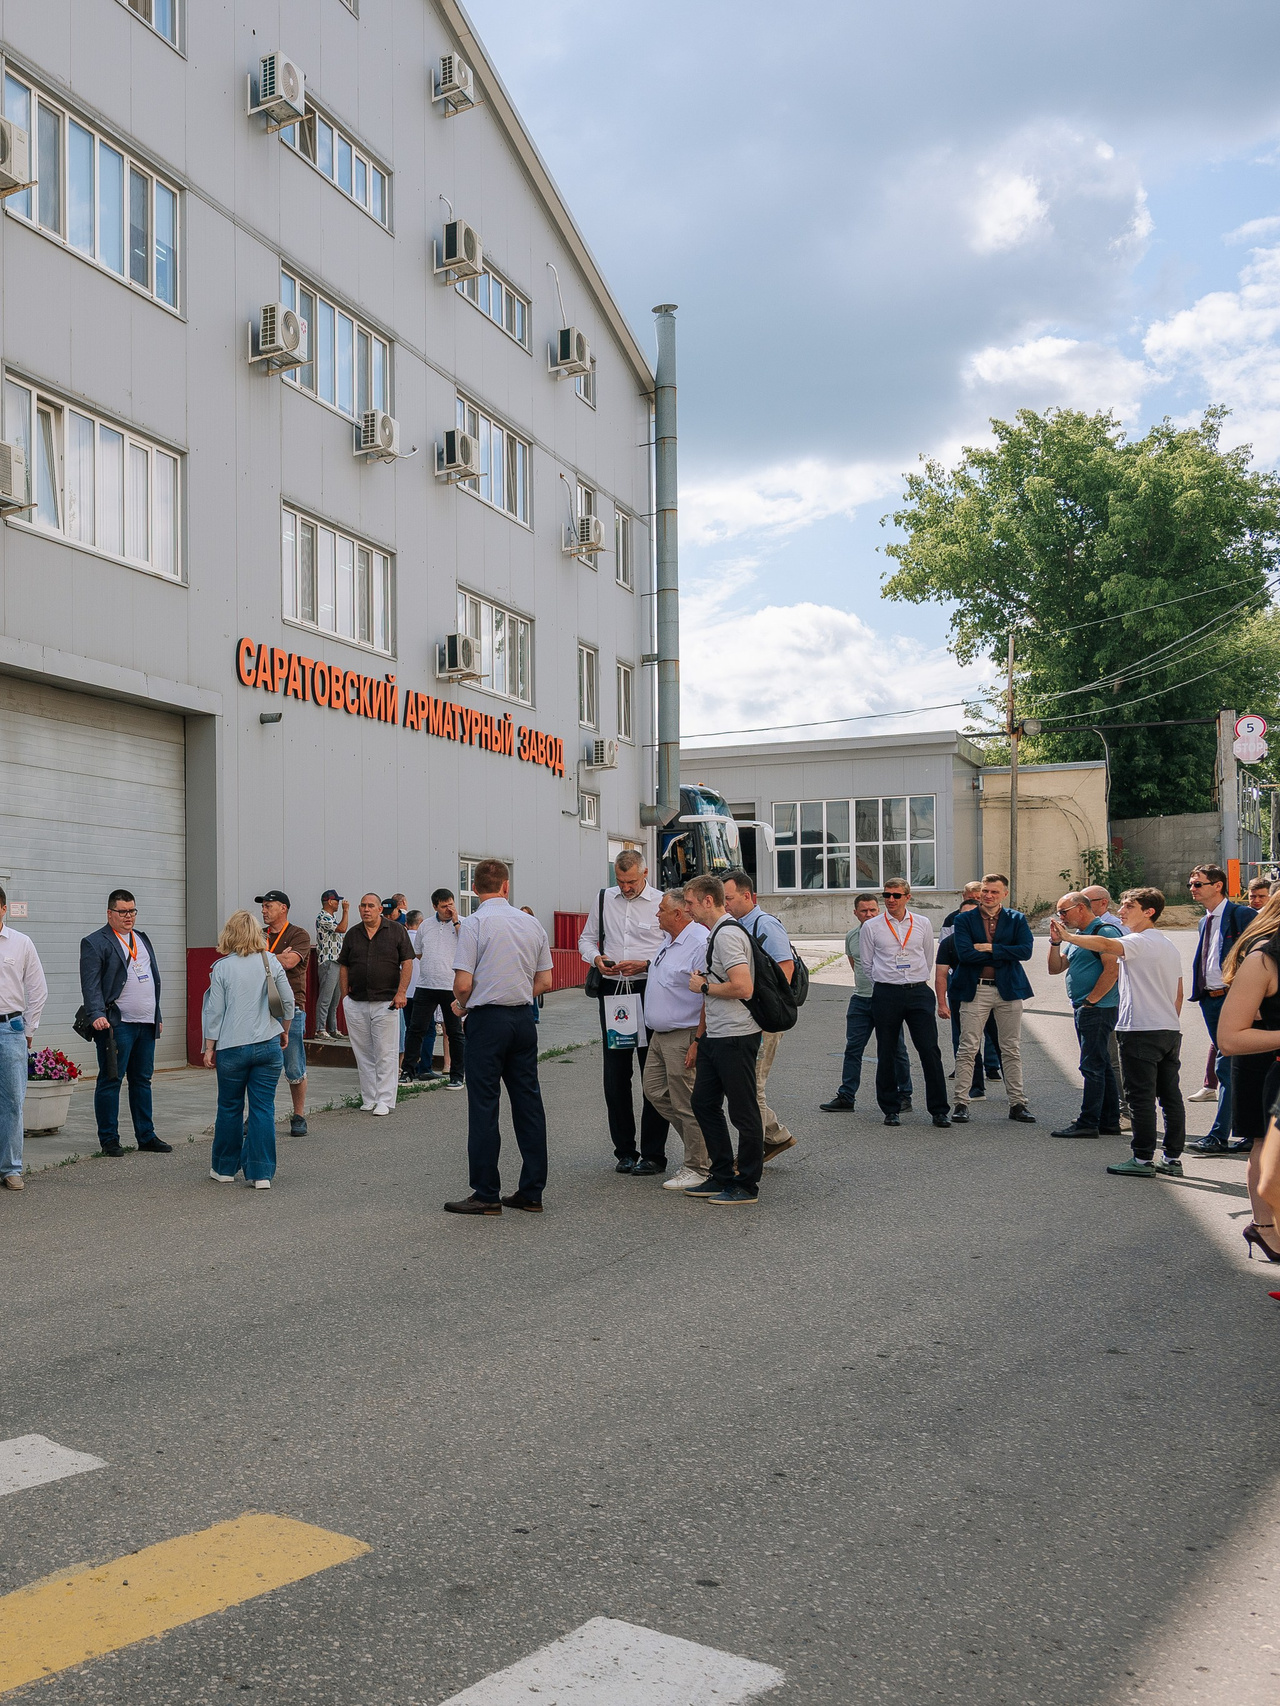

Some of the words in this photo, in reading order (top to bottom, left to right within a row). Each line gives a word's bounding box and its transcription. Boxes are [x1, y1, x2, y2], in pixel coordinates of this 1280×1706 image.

[236, 637, 399, 725] САРАТОВСКИЙ
[403, 690, 515, 757] АРМАТУРНЫЙ
[518, 725, 565, 778] ЗАВОД
[1246, 722, 1255, 733] 5
[1235, 742, 1264, 753] STOP
